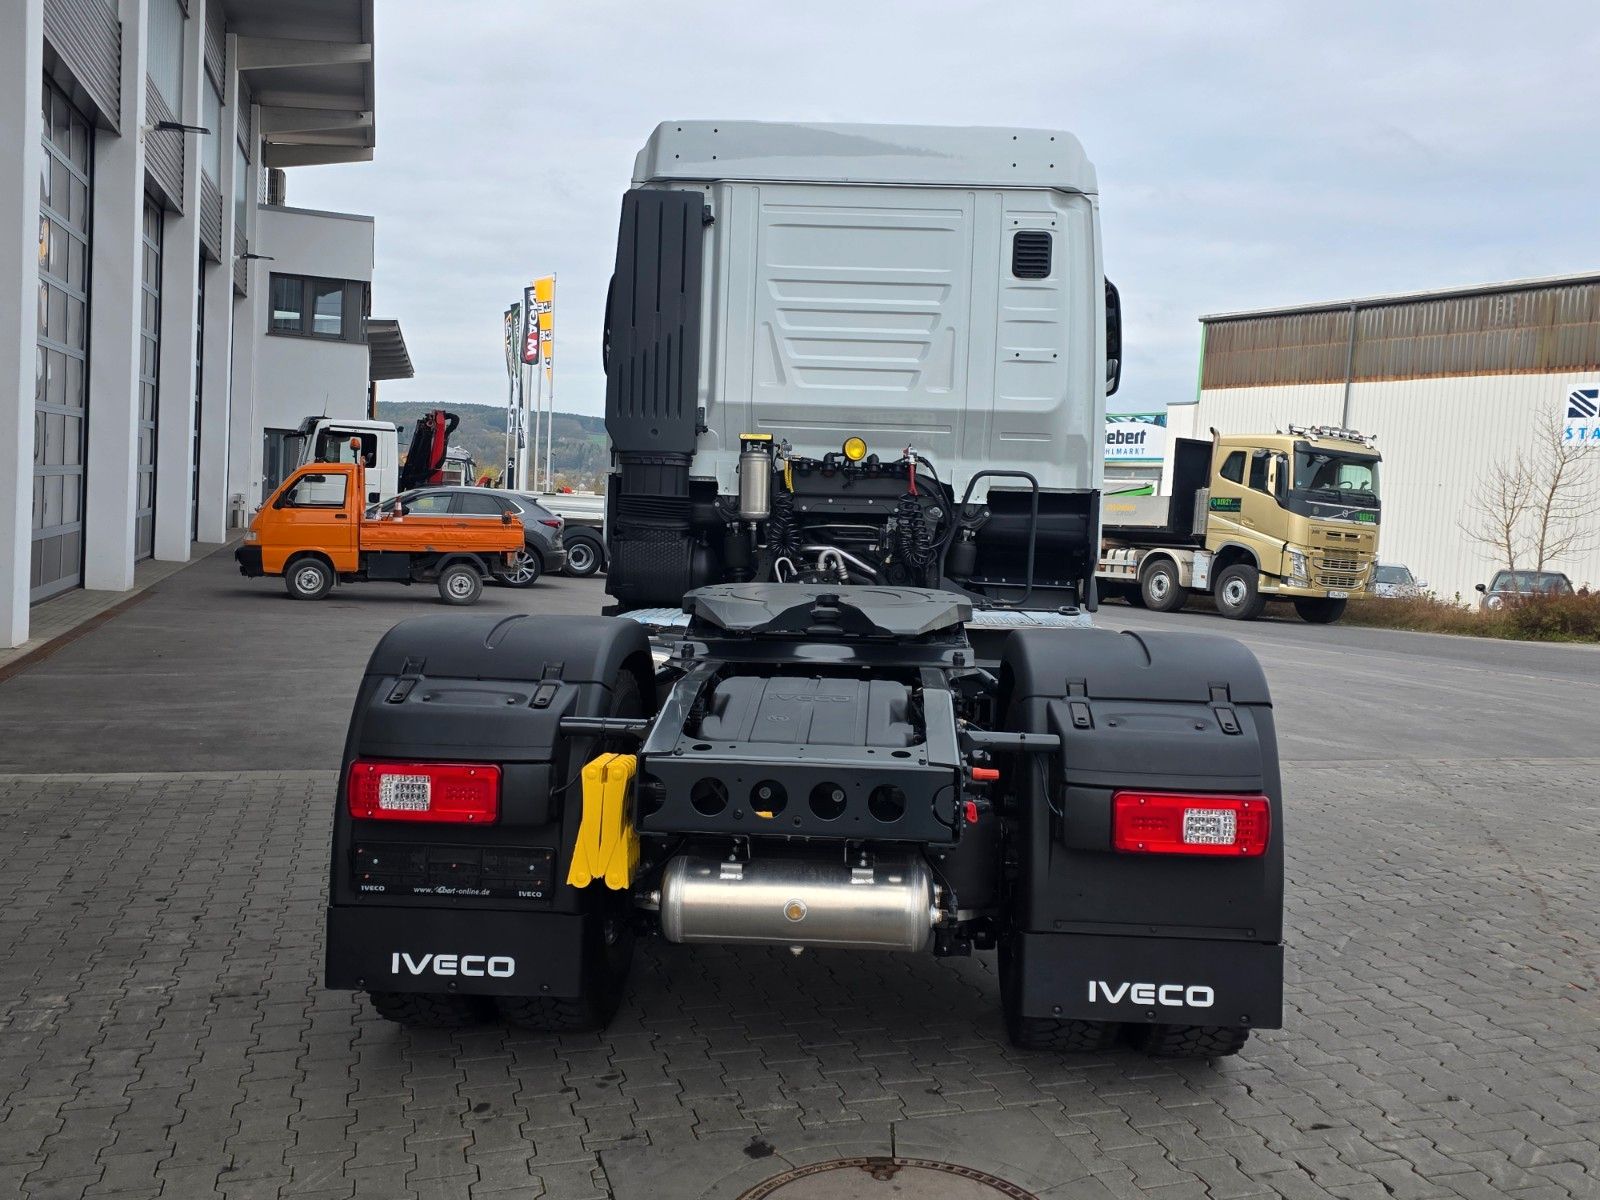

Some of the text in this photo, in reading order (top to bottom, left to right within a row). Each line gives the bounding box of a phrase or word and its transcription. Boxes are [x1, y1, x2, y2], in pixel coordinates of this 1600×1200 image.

[518, 890, 543, 898] IVECO
[391, 952, 515, 978] IVECO
[1088, 980, 1215, 1008] IVECO
